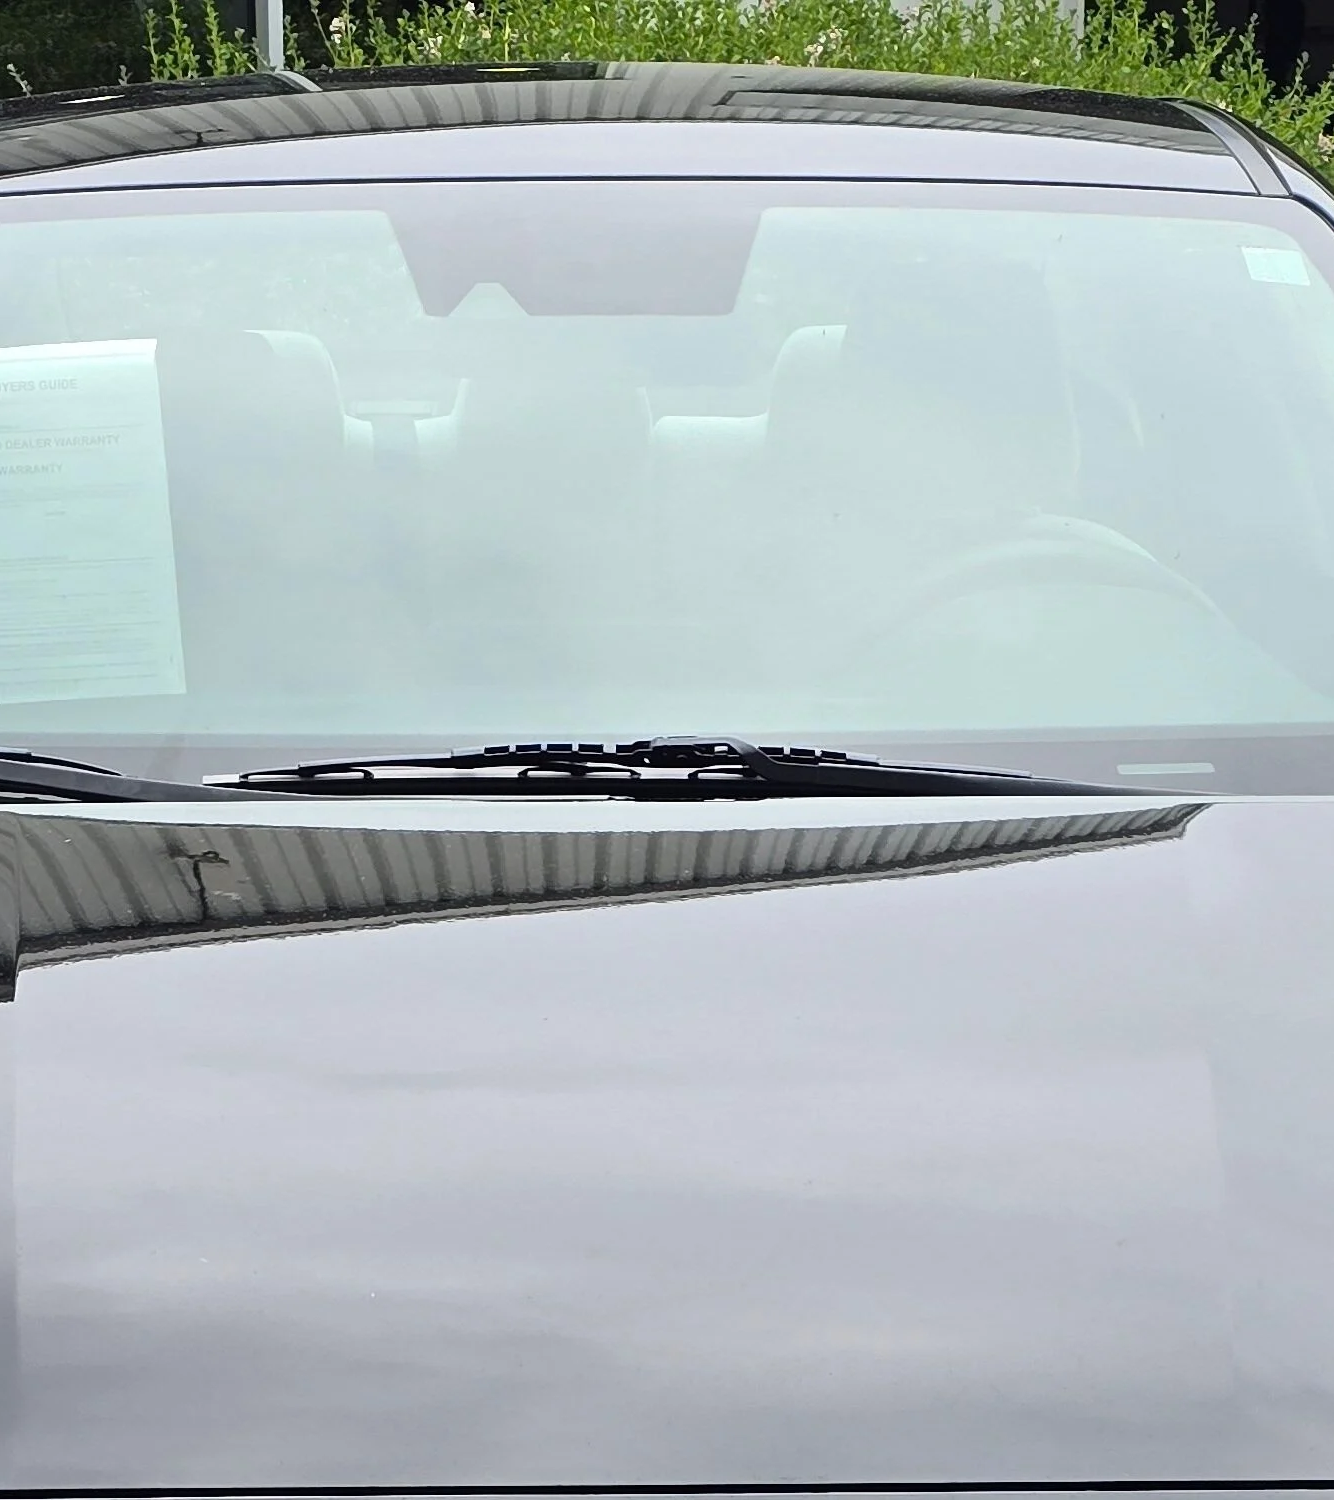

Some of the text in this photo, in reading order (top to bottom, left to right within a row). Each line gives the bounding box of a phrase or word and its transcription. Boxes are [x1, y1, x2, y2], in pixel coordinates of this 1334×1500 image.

[39, 378, 78, 391] GUIDE
[5, 437, 53, 450] DEALER
[54, 434, 121, 448] WARRANTY
